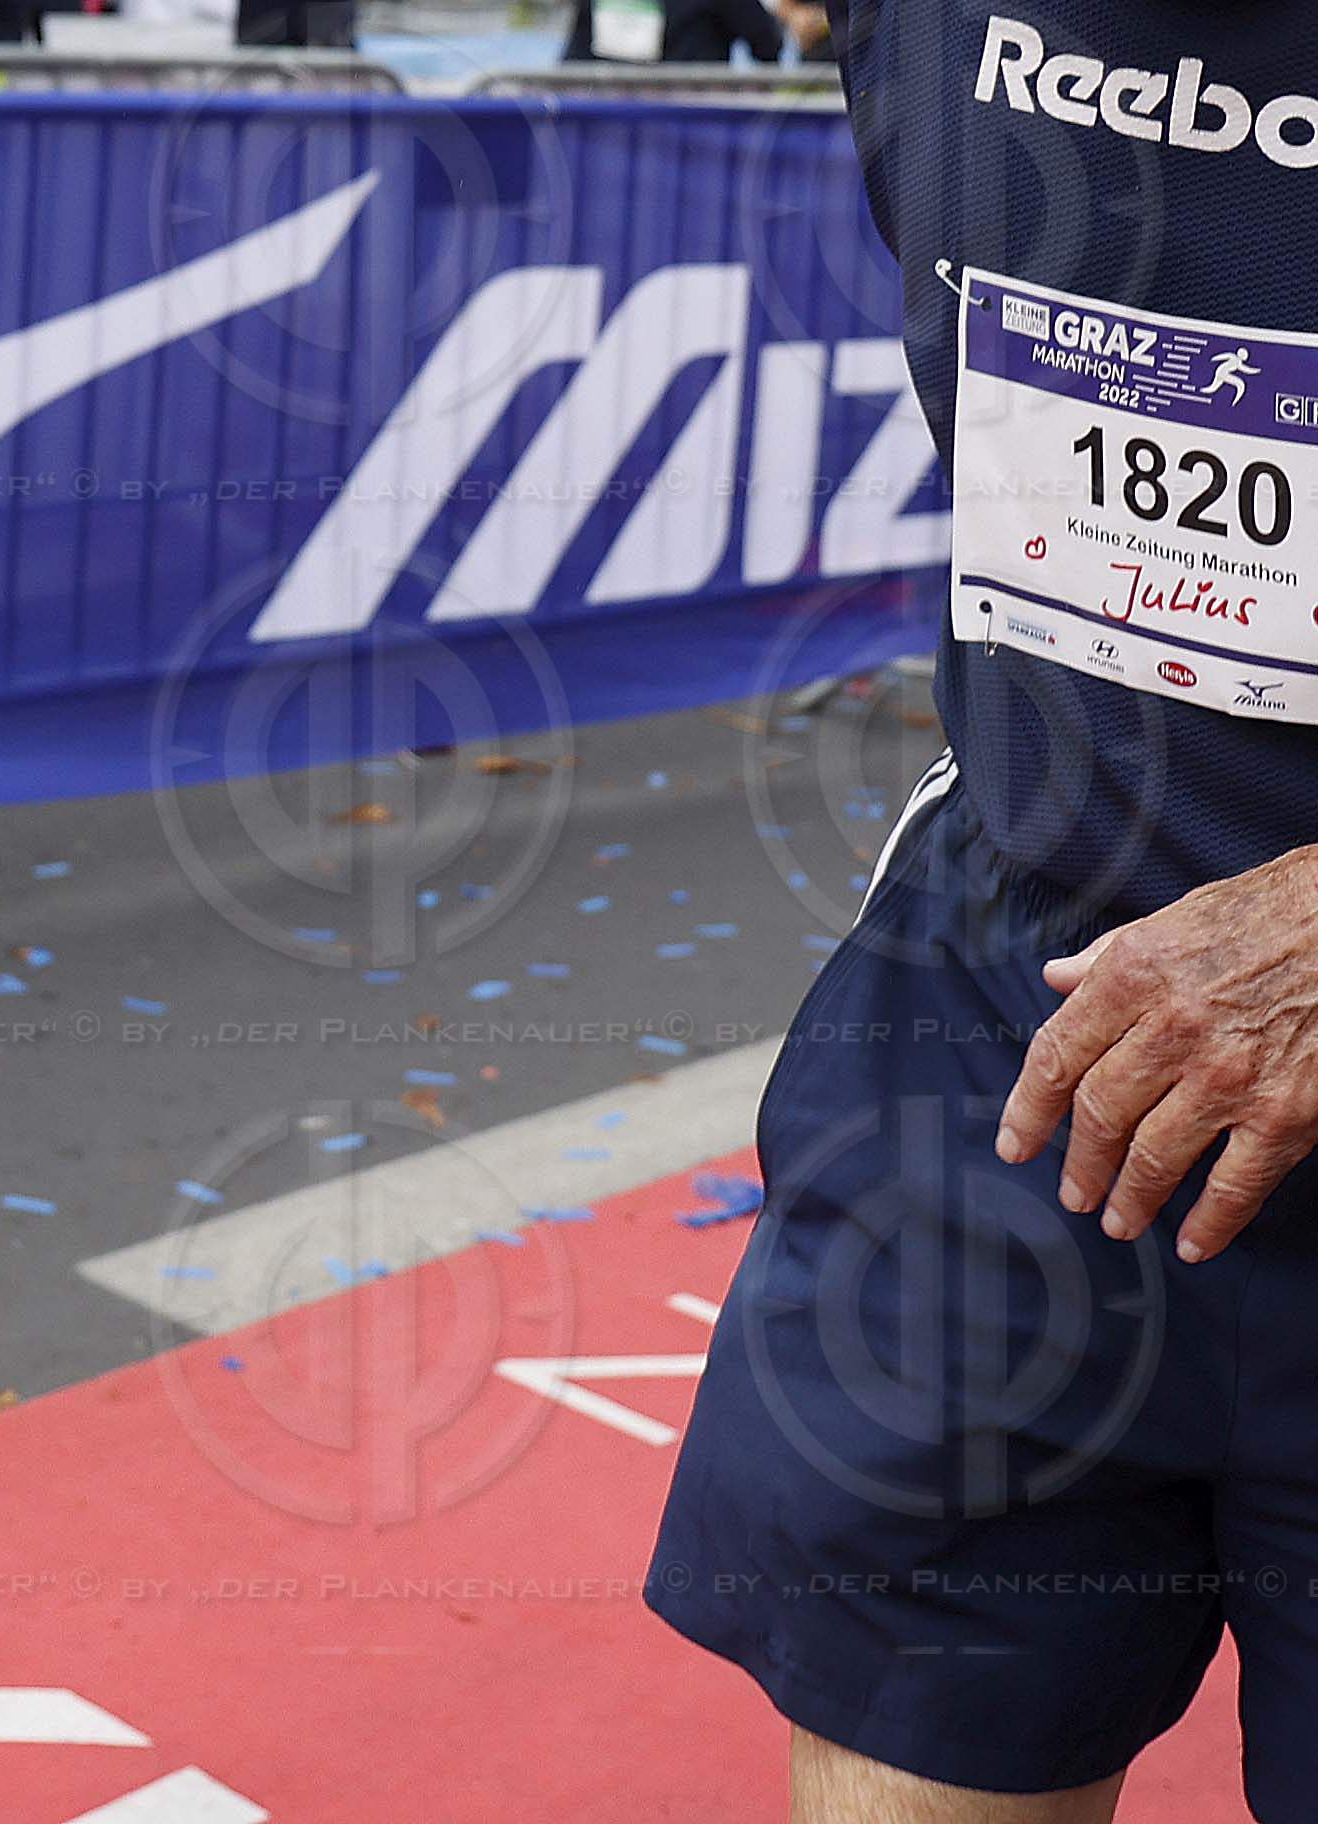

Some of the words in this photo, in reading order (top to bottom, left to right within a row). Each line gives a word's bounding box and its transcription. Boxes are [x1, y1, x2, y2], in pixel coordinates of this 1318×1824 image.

[1005, 299, 1047, 322] KLEINE
[1054, 310, 1158, 367] GRAZ
[1032, 344, 1125, 385] MARATHON
[1098, 383, 1141, 409] 2022
[1072, 425, 1292, 546] 1820
[1067, 517, 1121, 547] Kleine
[1125, 535, 1196, 569] Zeitung
[1201, 550, 1299, 587] Marathon
